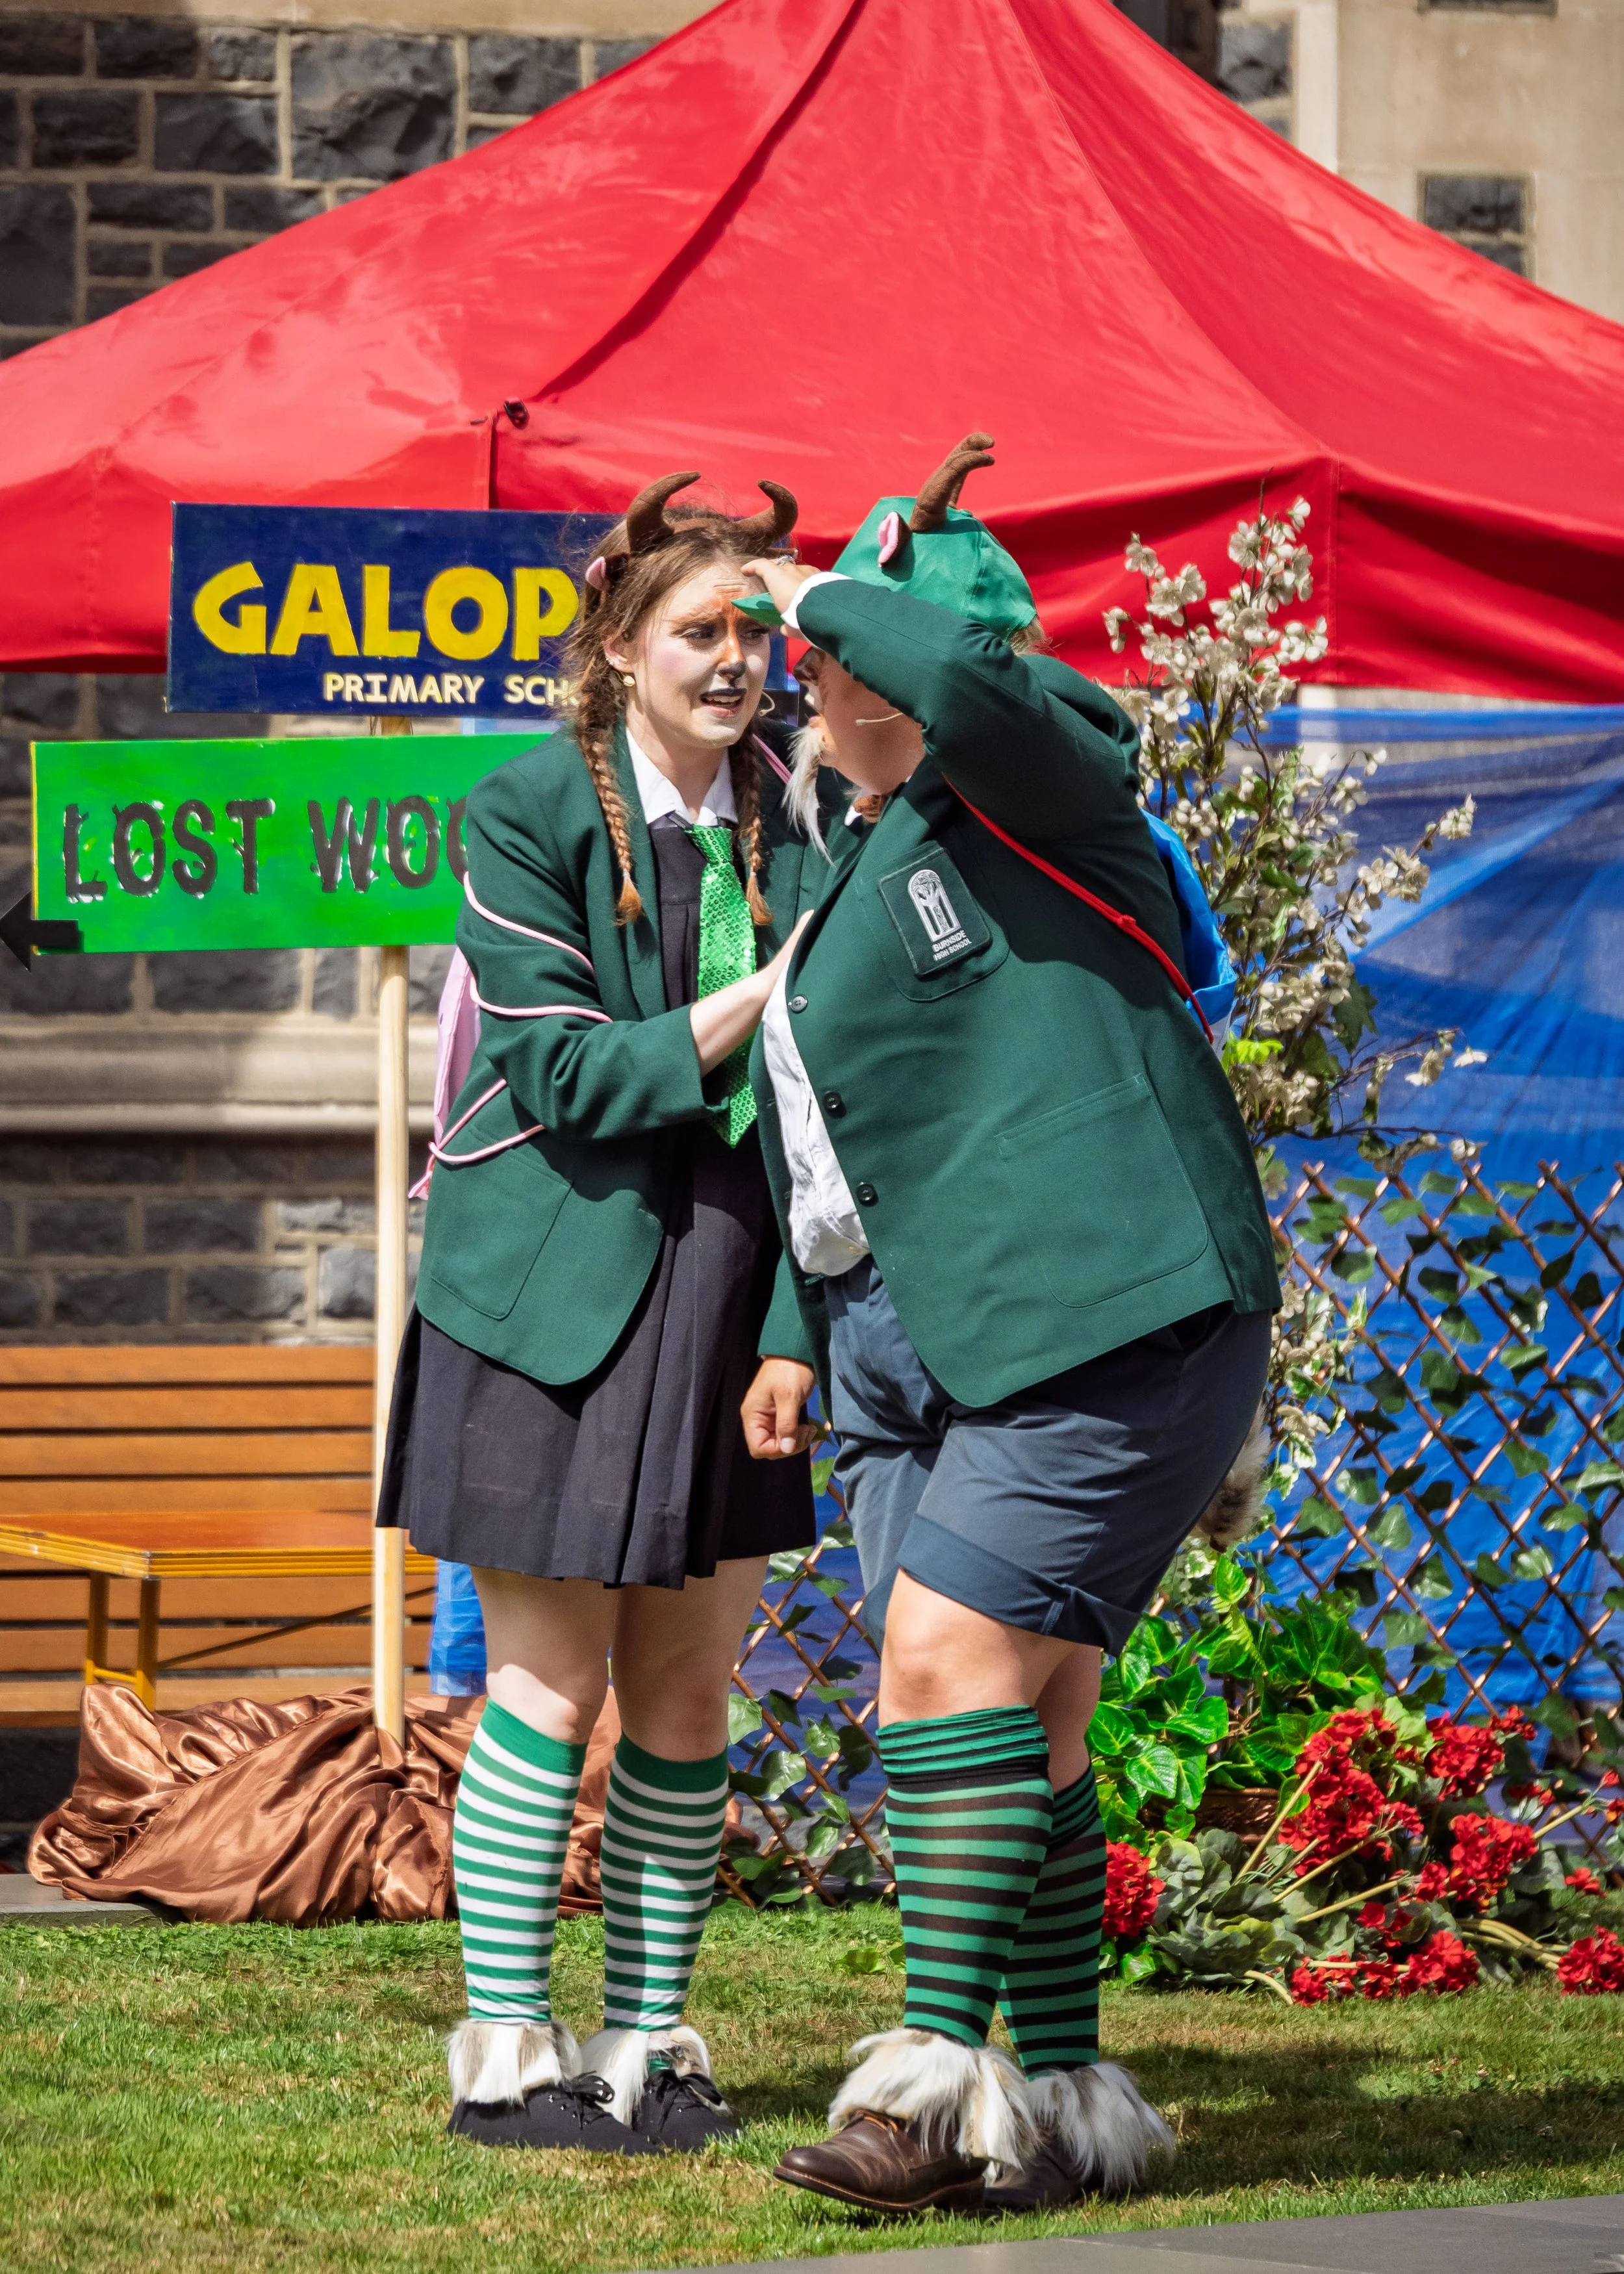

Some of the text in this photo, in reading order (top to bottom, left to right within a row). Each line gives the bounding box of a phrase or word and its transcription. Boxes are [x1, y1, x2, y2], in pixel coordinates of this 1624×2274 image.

[193, 561, 581, 660] GALOP
[325, 673, 485, 704] PRIMARY
[63, 798, 276, 904] LOST
[932, 930, 967, 952] BURNSIDE
[933, 938, 972, 961] HIGH SCHOOL
